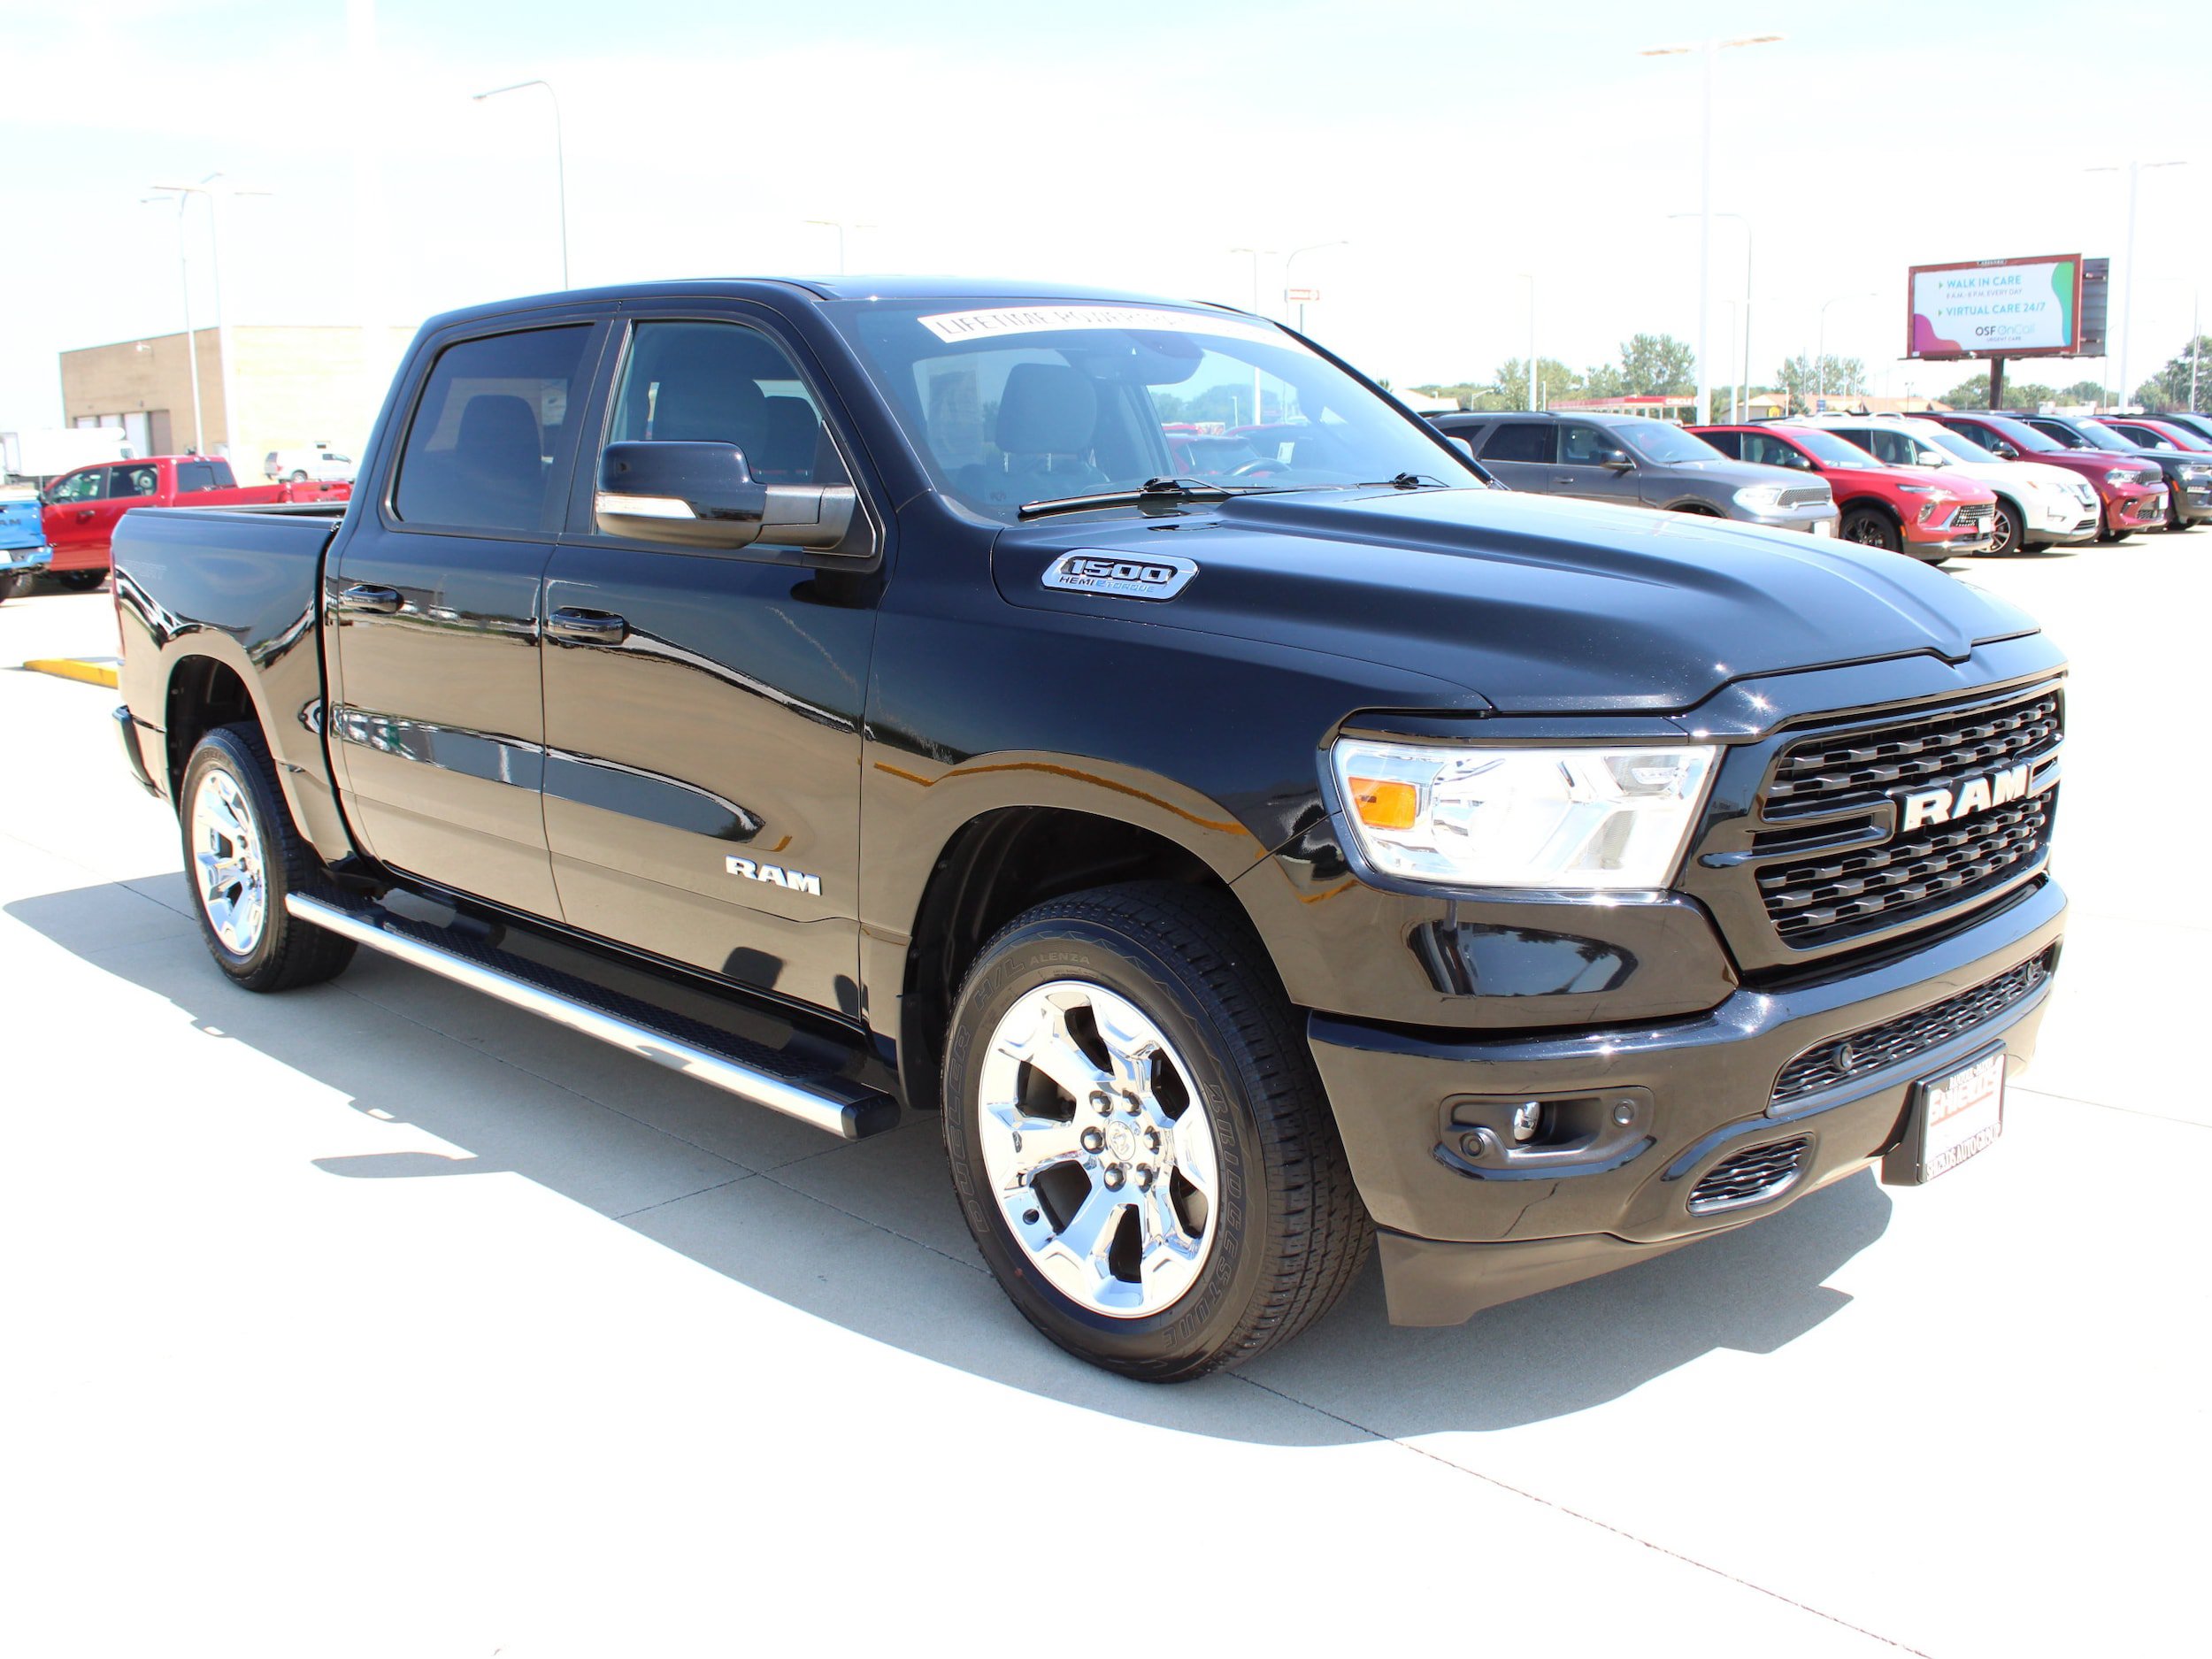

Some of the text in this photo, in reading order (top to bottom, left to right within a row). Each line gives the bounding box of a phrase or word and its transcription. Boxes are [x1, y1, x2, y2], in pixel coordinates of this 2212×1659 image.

[1947, 275, 2021, 288] WALK IN CARE
[935, 311, 1054, 334] LIFETIME
[1947, 303, 2046, 316] VIRTUAL CARE 24/7
[1975, 323, 2036, 336] OSF OnCall
[1058, 575, 1095, 587] HEMI
[1071, 558, 1172, 584] 1500
[1902, 763, 2028, 833] RAM
[725, 855, 823, 896] RAM
[949, 1024, 990, 1233] DUELER
[1028, 952, 1090, 966] ALENZA
[1955, 1135, 1977, 1163] AUTO
[1164, 1081, 1242, 1350] BRIDGESTONE
